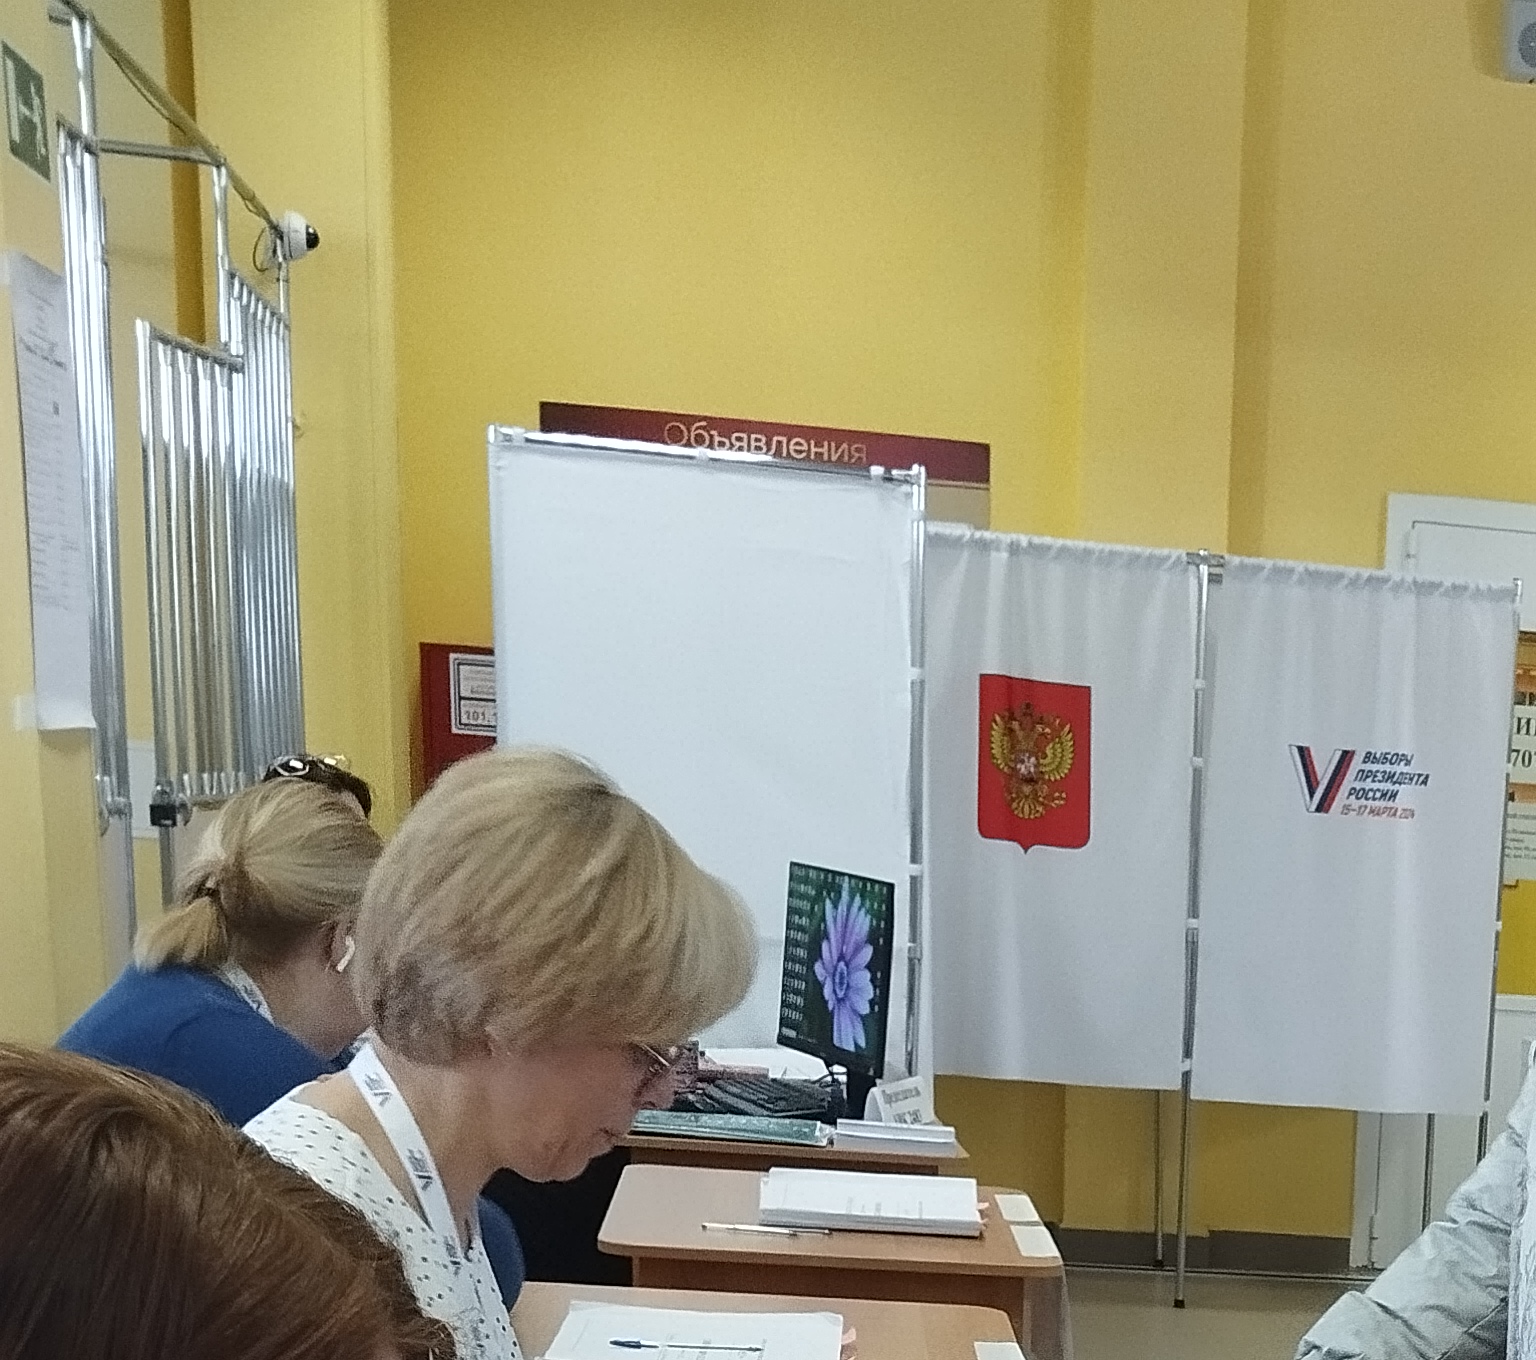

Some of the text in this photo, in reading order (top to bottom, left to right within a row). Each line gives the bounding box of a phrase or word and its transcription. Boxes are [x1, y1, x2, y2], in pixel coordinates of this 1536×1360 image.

[664, 421, 867, 465] Объявления
[1361, 750, 1415, 767] ВЫБОРЫ
[1353, 768, 1431, 788] ПРЕЗИДЕНТА
[1346, 786, 1400, 803] РОССИИ
[1367, 805, 1399, 818] МАРТА
